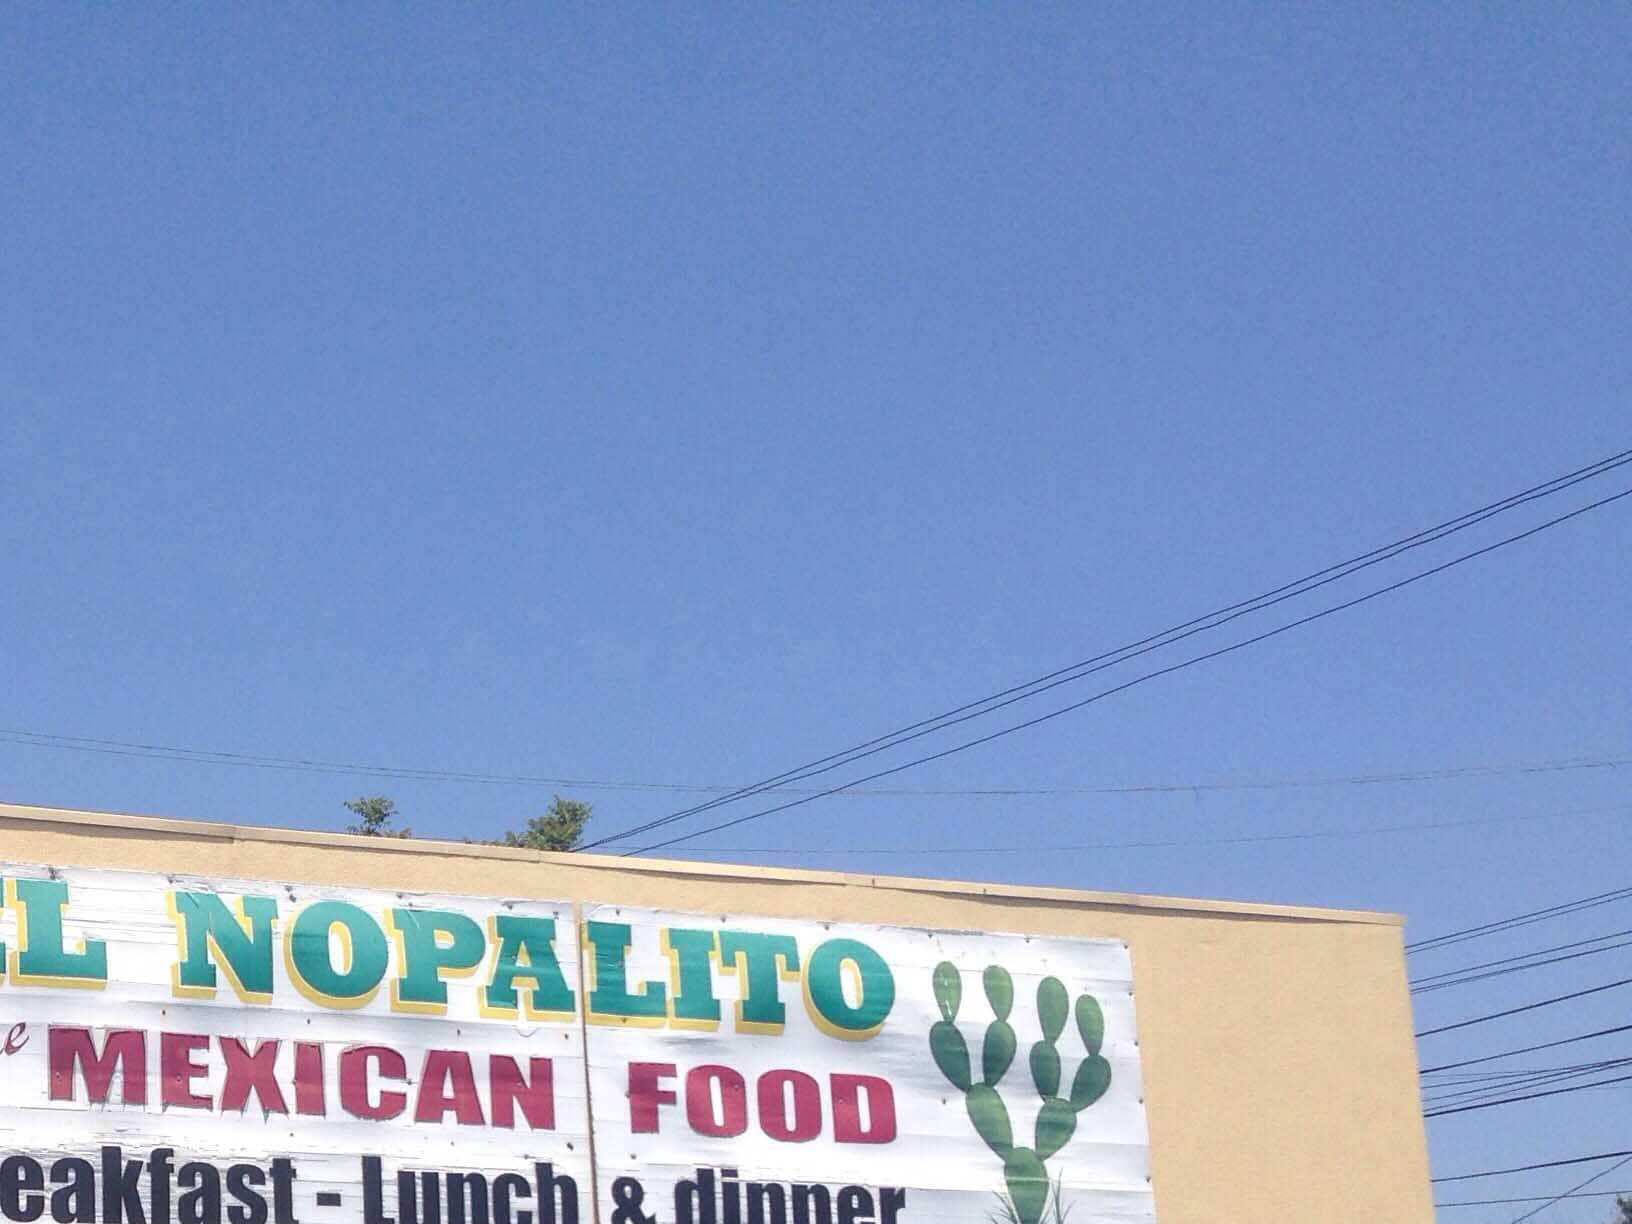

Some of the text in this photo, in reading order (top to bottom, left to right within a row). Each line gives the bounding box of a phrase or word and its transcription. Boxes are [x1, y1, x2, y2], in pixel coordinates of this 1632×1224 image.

[171, 889, 895, 1042] NOPALITO
[48, 1024, 556, 1131] MEXICAN
[628, 1061, 897, 1144] FOOD
